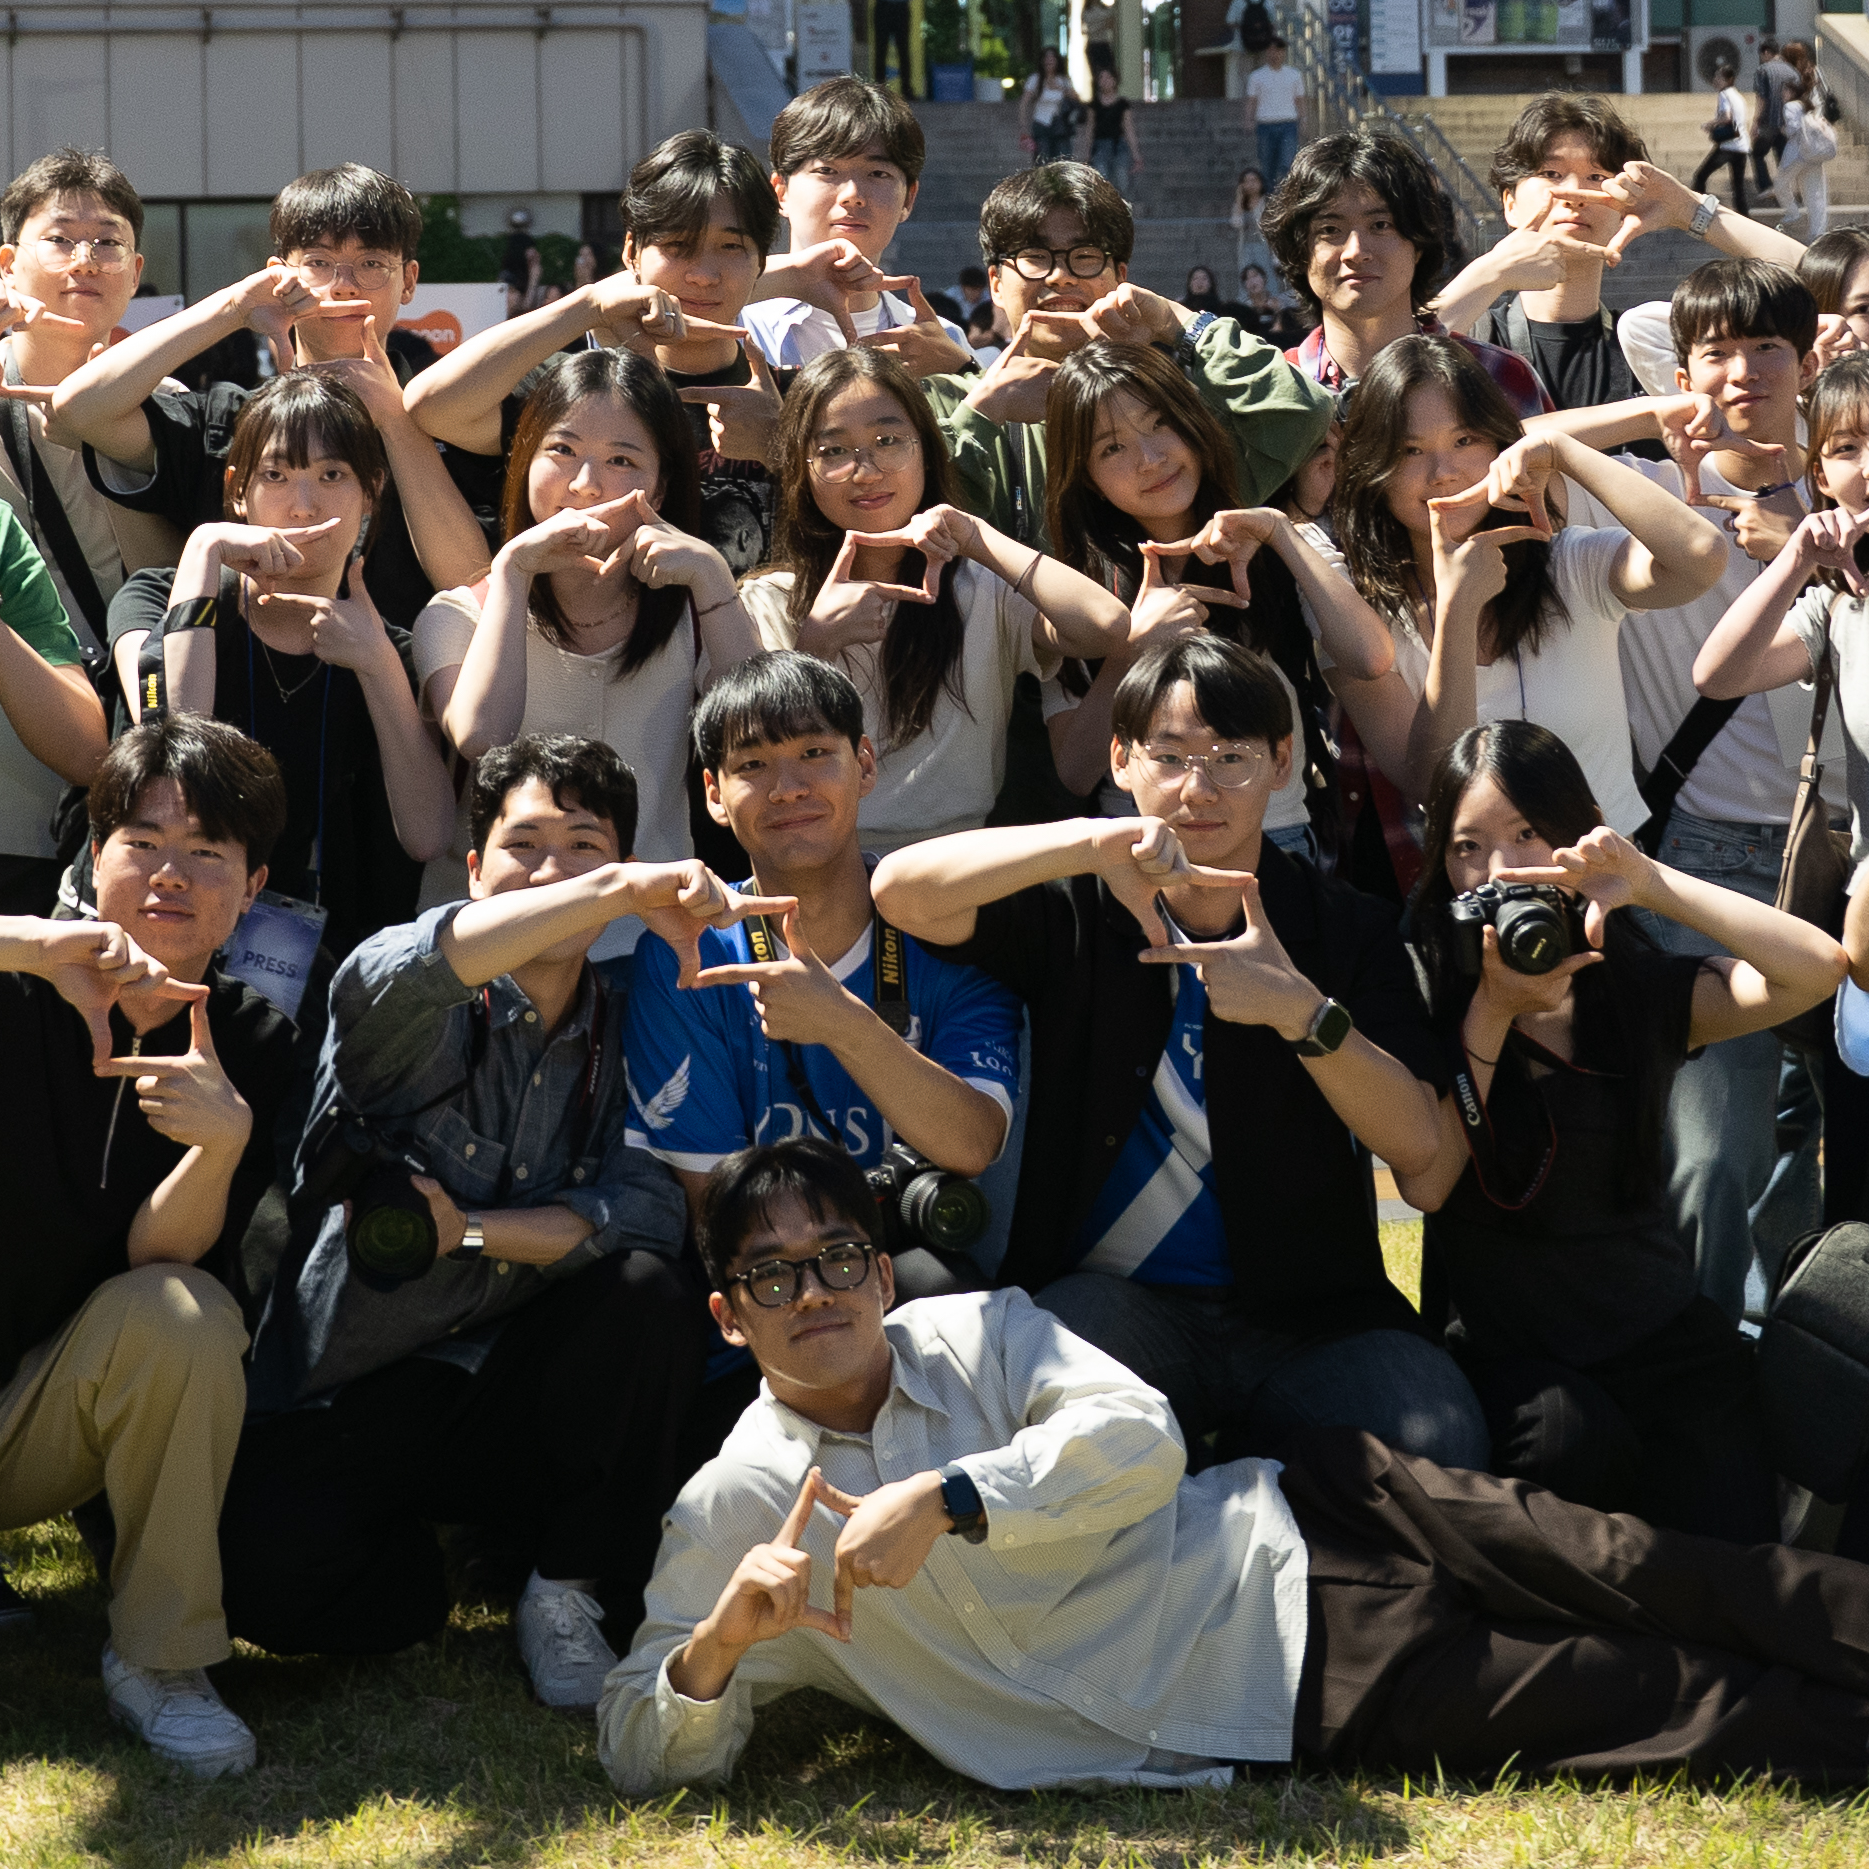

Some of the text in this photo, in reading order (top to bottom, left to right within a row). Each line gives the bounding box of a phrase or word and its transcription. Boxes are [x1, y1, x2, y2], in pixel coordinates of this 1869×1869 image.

[146, 673, 159, 709] Nikon
[1509, 886, 1533, 895] Canon
[242, 950, 300, 979] PRESS
[882, 928, 901, 986] Nikon
[1455, 1072, 1481, 1127] Canon
